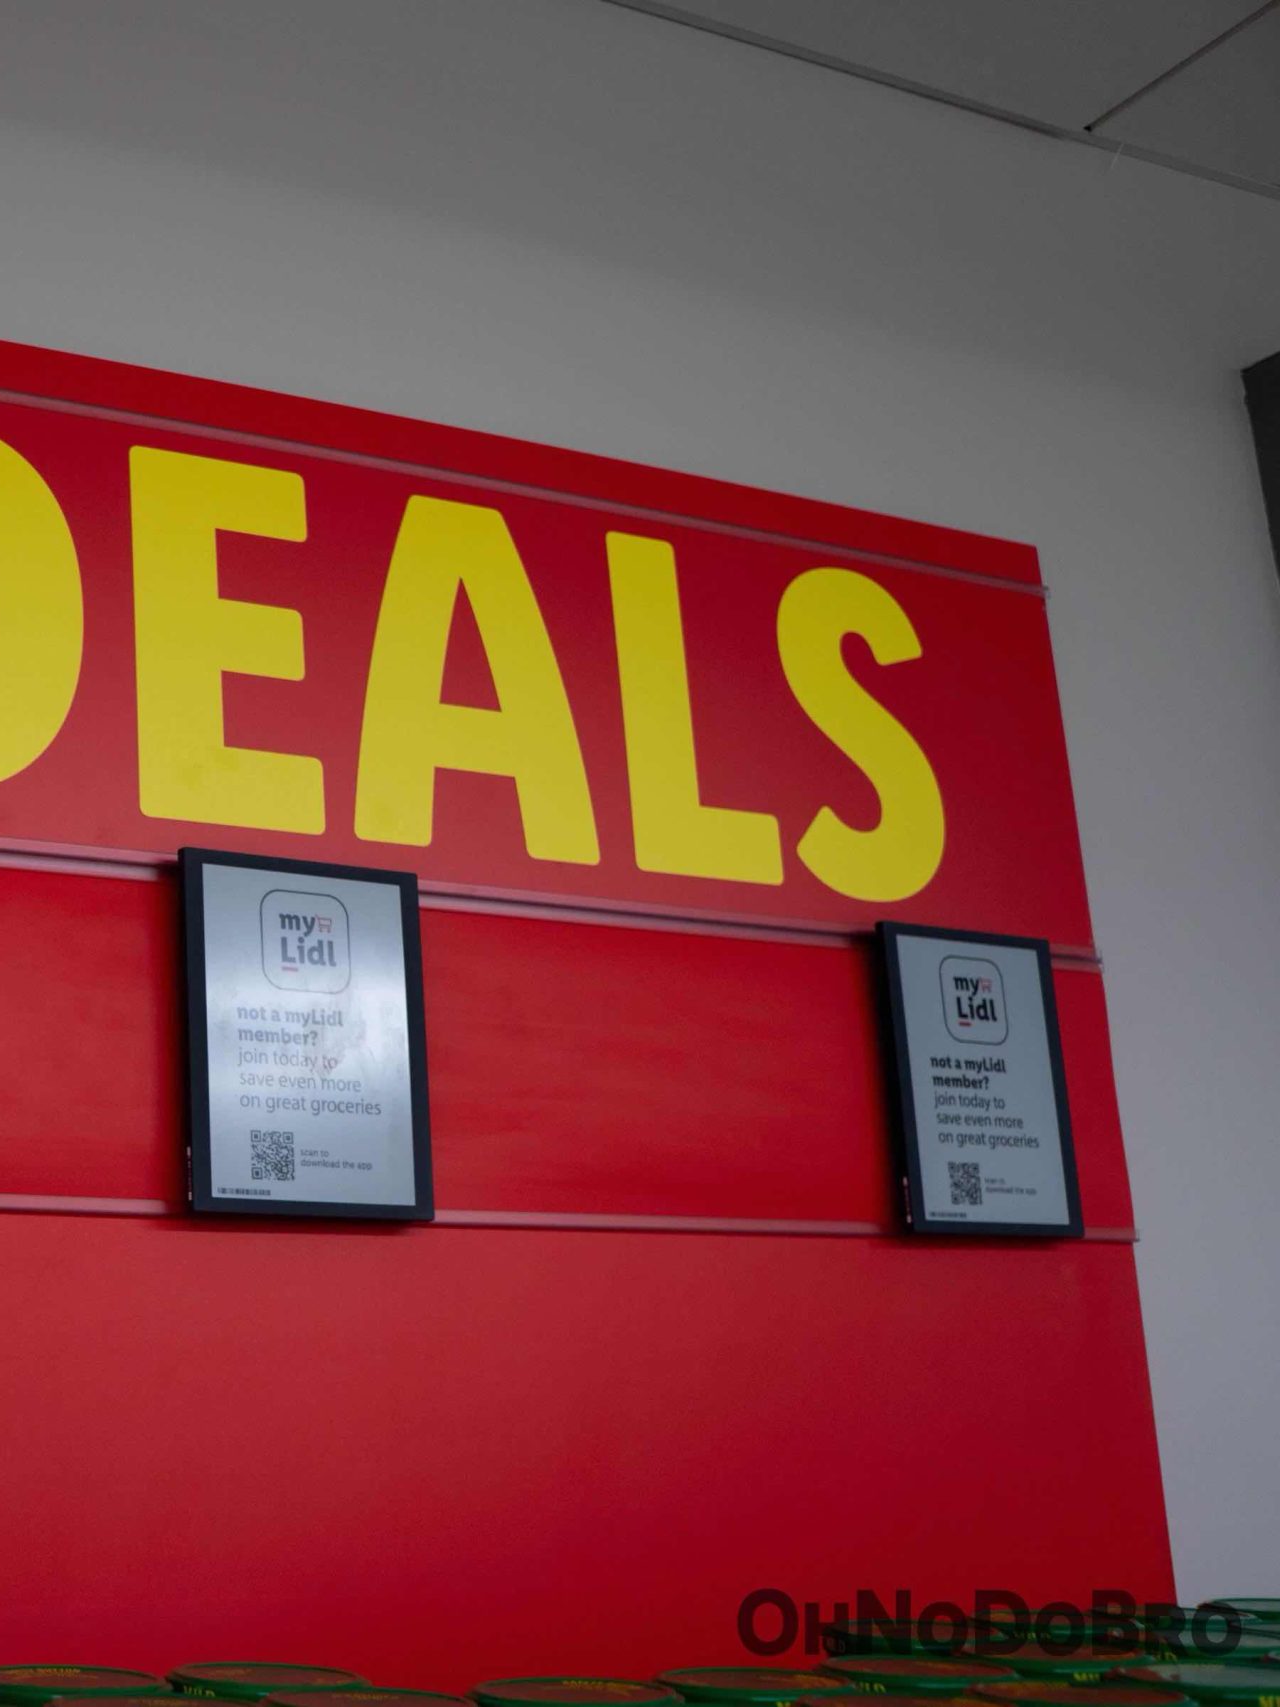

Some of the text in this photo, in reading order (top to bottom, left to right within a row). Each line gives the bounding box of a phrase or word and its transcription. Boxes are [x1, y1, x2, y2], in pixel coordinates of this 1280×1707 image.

[279, 913, 316, 937] my
[281, 936, 337, 968] Lidl
[953, 976, 980, 997] my
[237, 1006, 344, 1028] not a myLidl
[956, 995, 998, 1023] Lidl
[238, 1027, 318, 1047] member?
[237, 1046, 339, 1074] join today to
[930, 1056, 1007, 1075] not a myLidl
[239, 1072, 363, 1093] save even more
[932, 1075, 990, 1091] member?
[239, 1094, 382, 1116] on great groceries
[934, 1090, 1006, 1112] join today to
[936, 1113, 1024, 1130] save even more
[938, 1132, 1040, 1151] on great groceries
